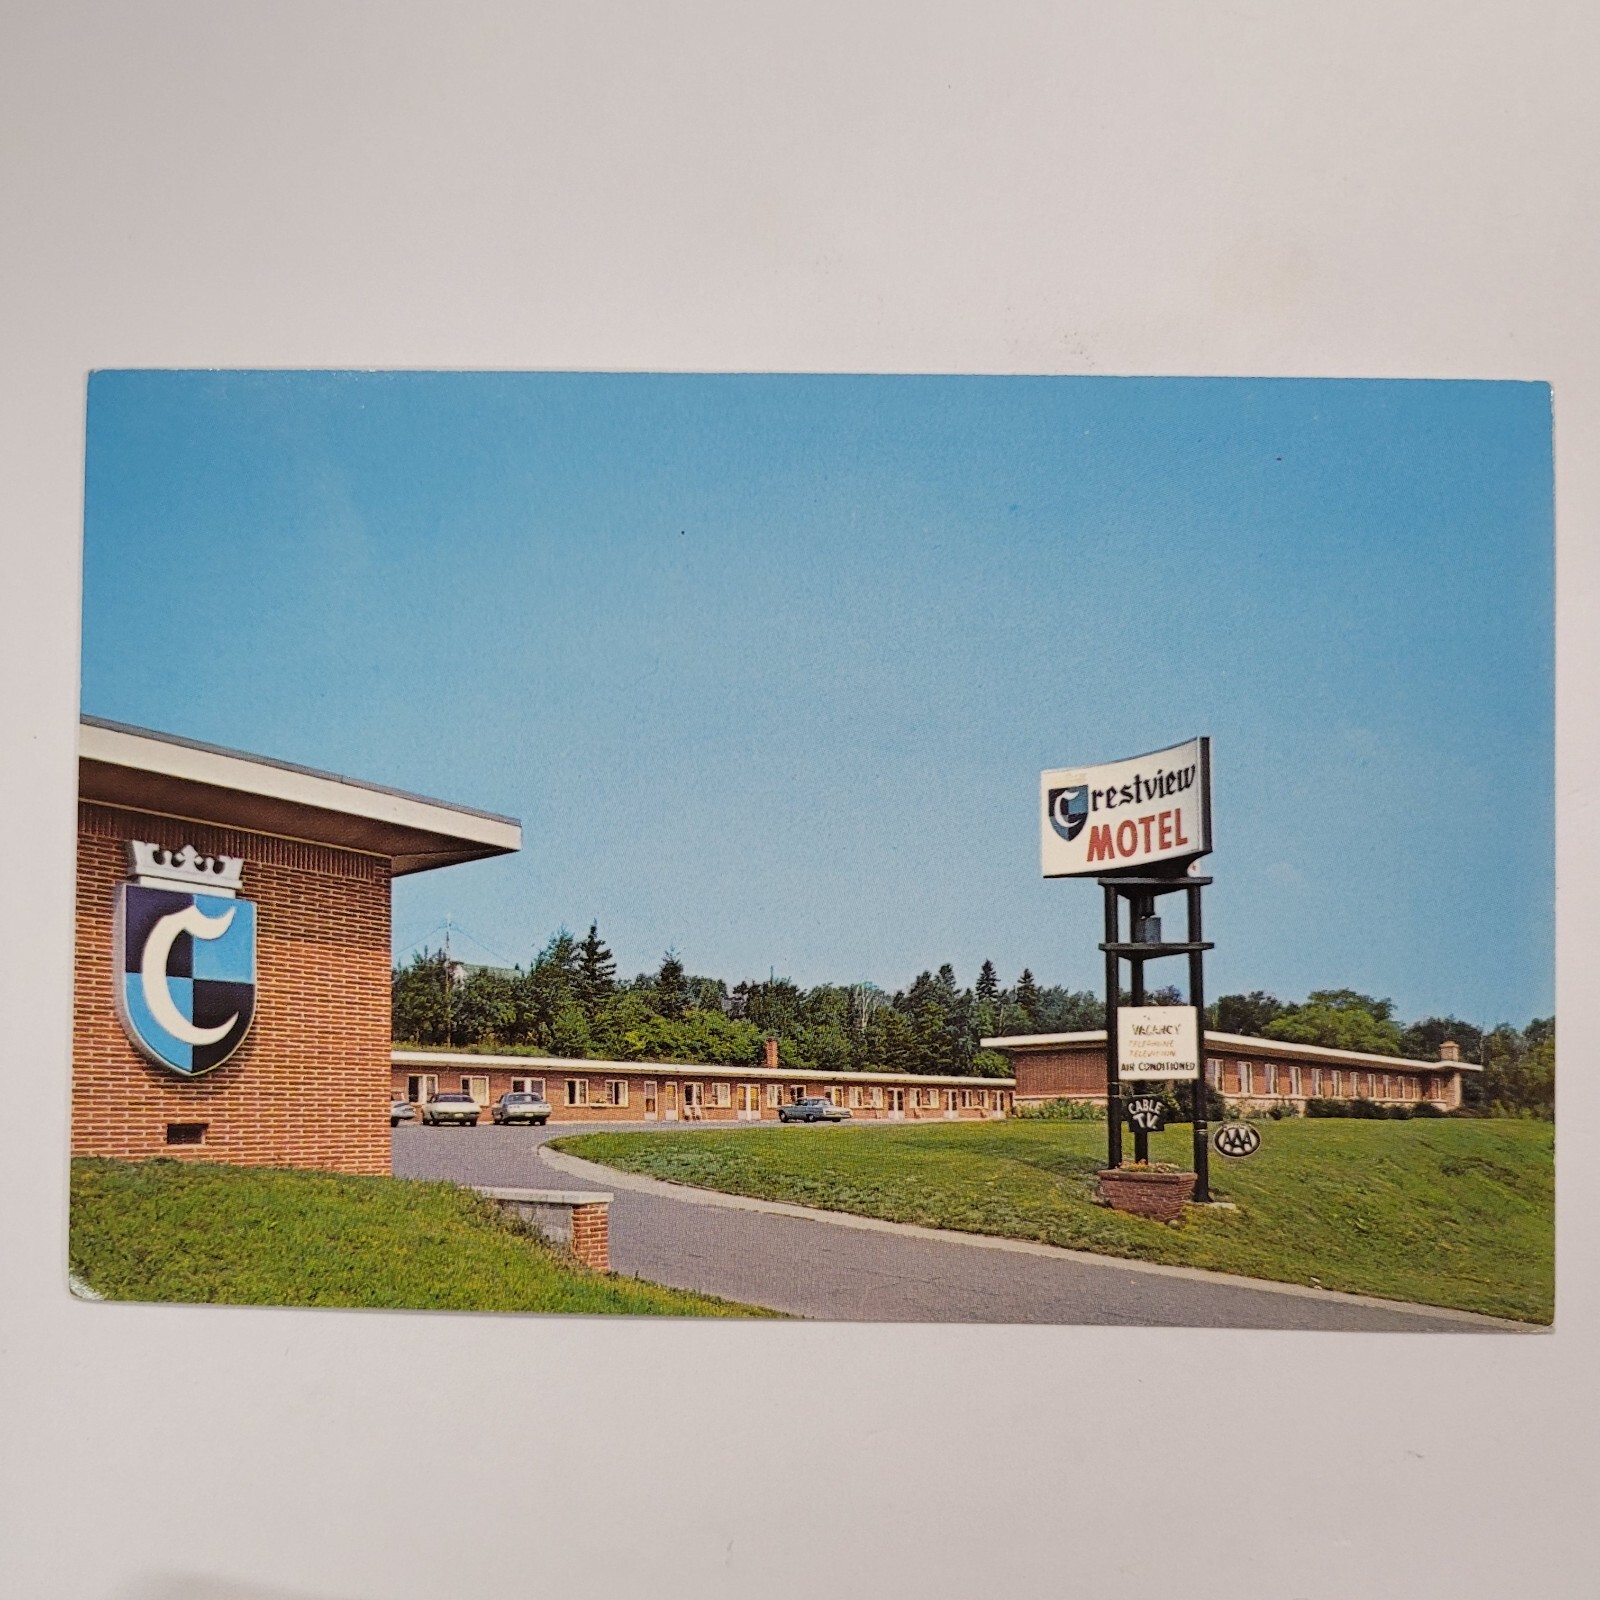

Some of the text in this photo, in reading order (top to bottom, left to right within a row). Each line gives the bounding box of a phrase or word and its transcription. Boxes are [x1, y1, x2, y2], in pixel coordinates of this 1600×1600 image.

[1086, 808, 1188, 862] MOTEL
[1120, 1061, 1196, 1072] AIR CONDITIONED
[1128, 1099, 1164, 1115] CABLE
[1222, 1128, 1254, 1150] AAA
